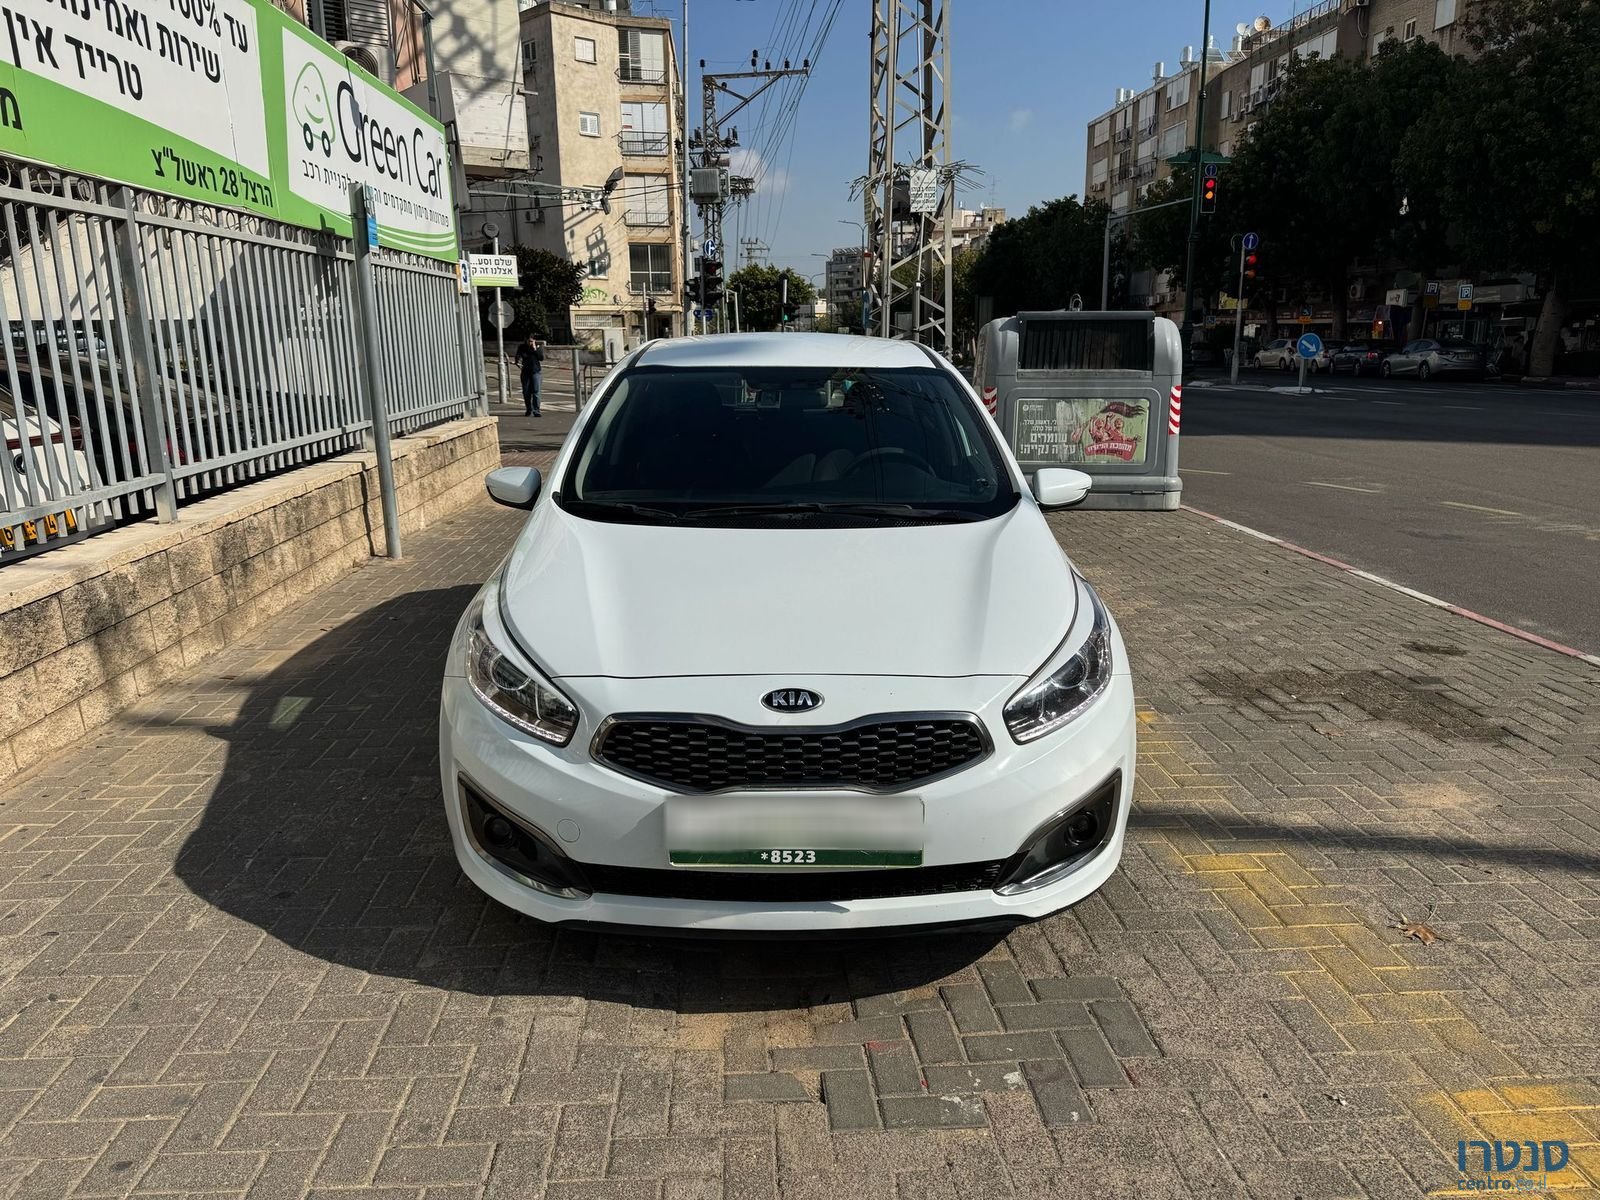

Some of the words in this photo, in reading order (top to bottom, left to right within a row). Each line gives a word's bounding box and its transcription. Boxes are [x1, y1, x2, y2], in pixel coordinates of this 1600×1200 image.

[1, 6, 60, 70] אין
[223, 12, 248, 53] עד
[156, 21, 221, 84] שירות
[64, 34, 143, 101] טרייד
[337, 80, 411, 186] Green
[413, 127, 443, 200] Car
[220, 166, 239, 198] 28
[302, 159, 321, 182] רכב
[240, 171, 273, 208] הרצל
[480, 267, 489, 275] זה
[490, 266, 513, 275] אצלנו
[494, 257, 513, 266] שלם
[1020, 443, 1049, 456] נקייה!
[1030, 432, 1067, 443] שומרים
[772, 691, 813, 706] KIA
